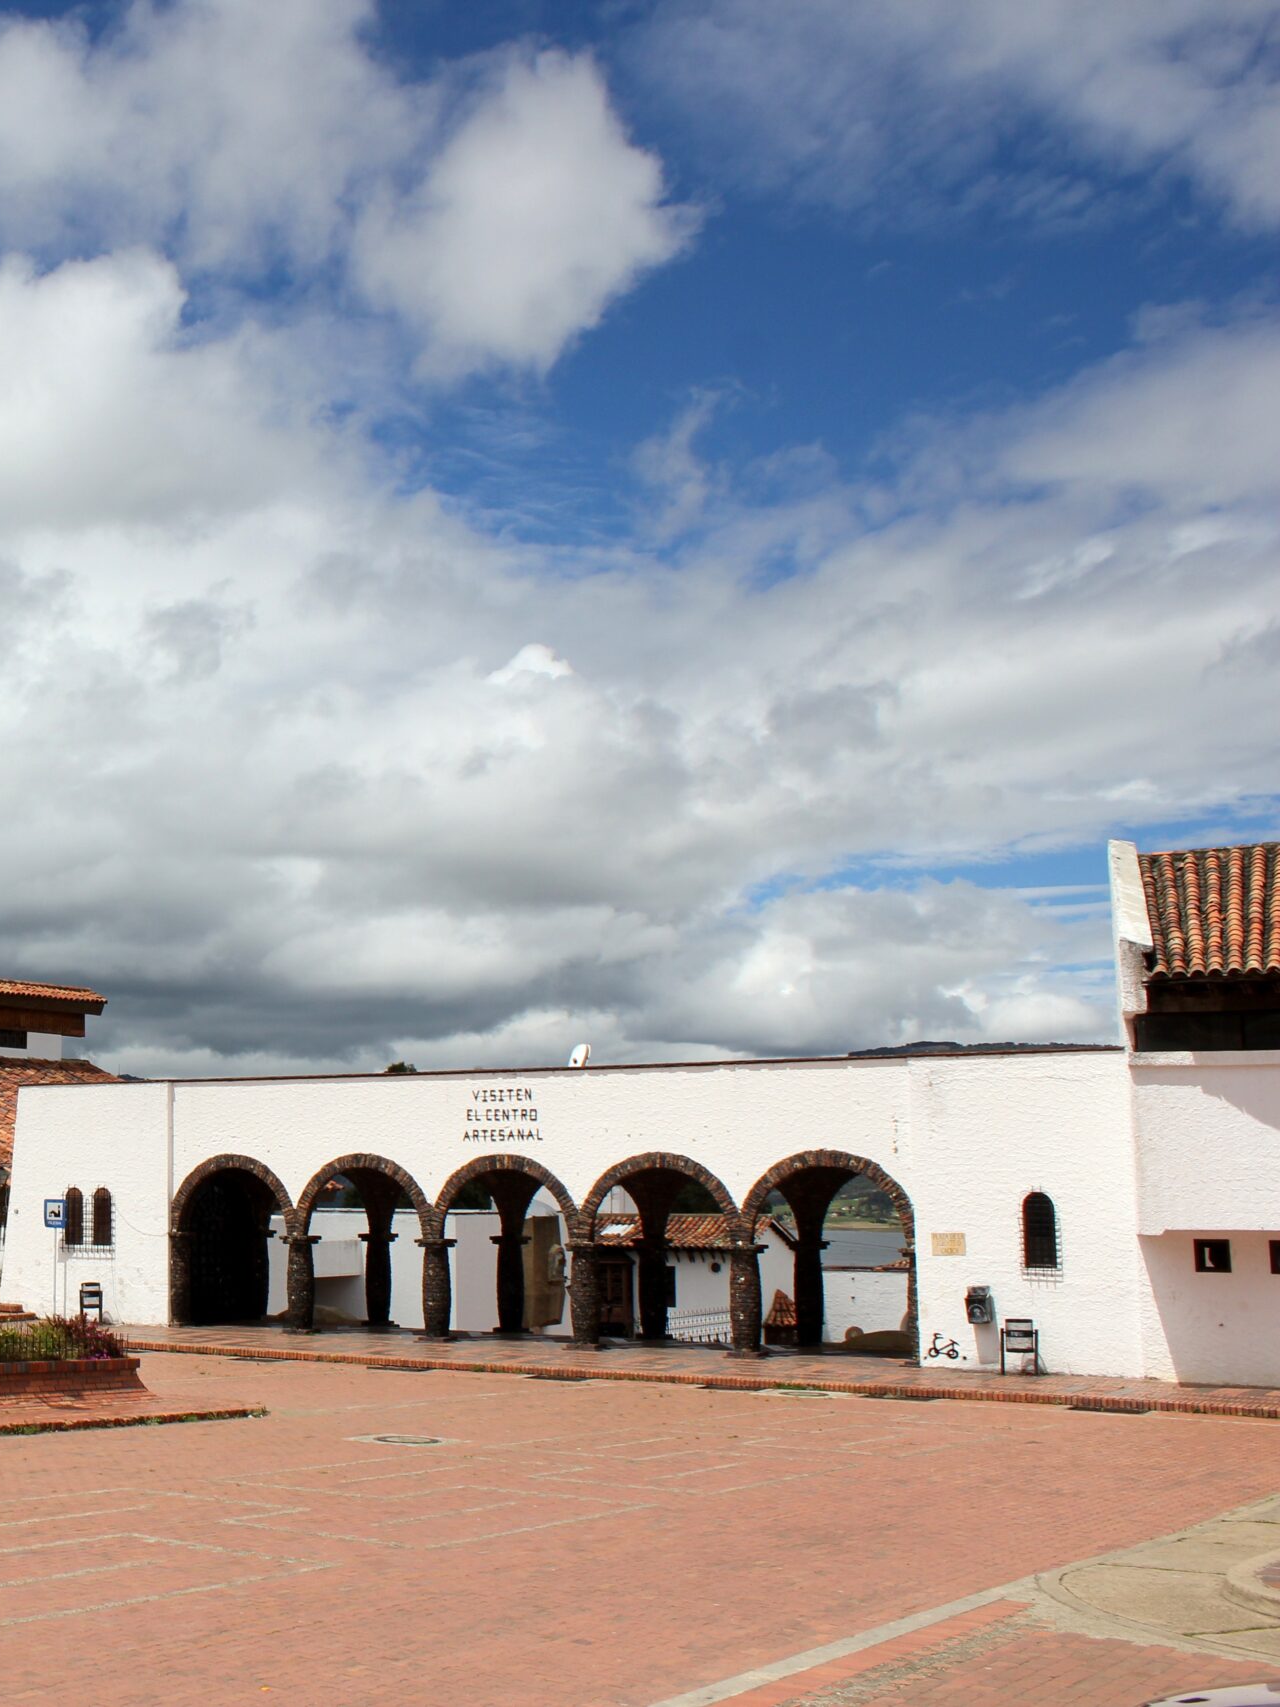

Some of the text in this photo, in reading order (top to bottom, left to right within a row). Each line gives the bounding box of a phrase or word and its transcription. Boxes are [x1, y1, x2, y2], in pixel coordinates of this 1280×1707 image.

[472, 1088, 532, 1102] VISITEN
[466, 1109, 538, 1121] EL CENTRO
[463, 1128, 543, 1142] ARTESANAL
